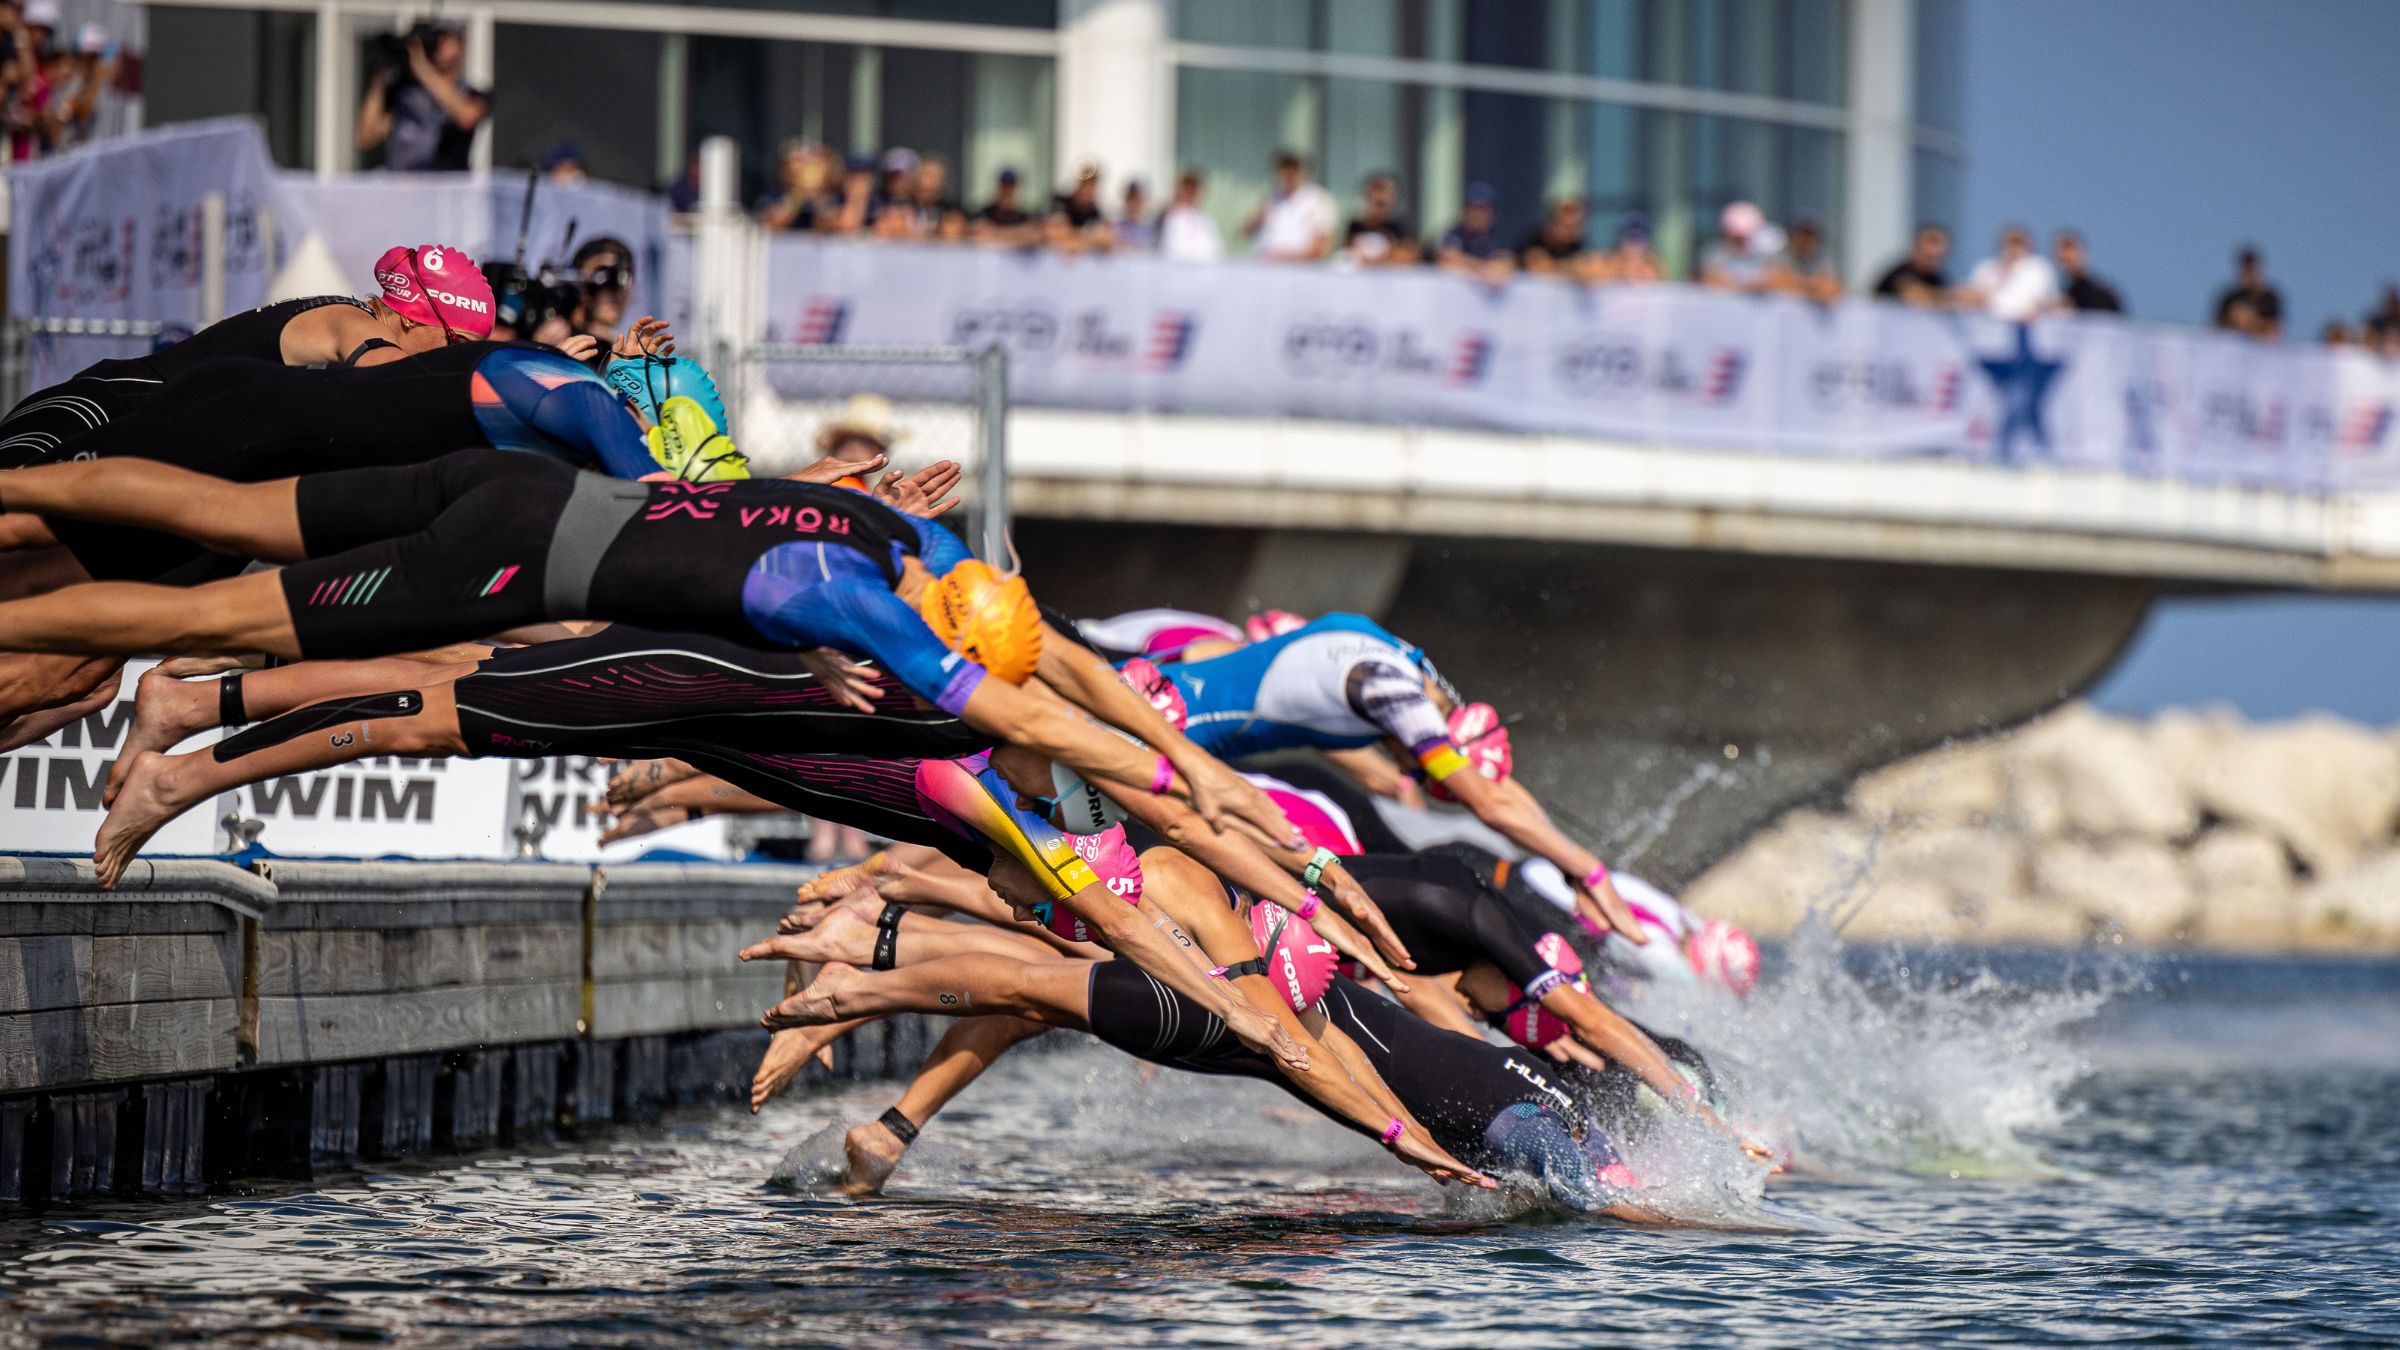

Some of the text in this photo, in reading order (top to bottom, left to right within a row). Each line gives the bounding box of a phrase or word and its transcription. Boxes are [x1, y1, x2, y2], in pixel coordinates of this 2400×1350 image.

[423, 248, 444, 271] 6
[426, 288, 488, 314] FORM
[398, 696, 408, 708] KT
[330, 731, 354, 748] 3
[248, 775, 437, 823] WIM
[1086, 782, 1106, 828] ORM
[1107, 876, 1134, 896] 5
[1170, 927, 1192, 948] 5
[1306, 938, 1333, 955] 7
[1278, 946, 1308, 1013] FORM
[940, 993, 957, 1005] 8
[1526, 1002, 1539, 1043] ORM
[1503, 1057, 1574, 1108] HUUB
